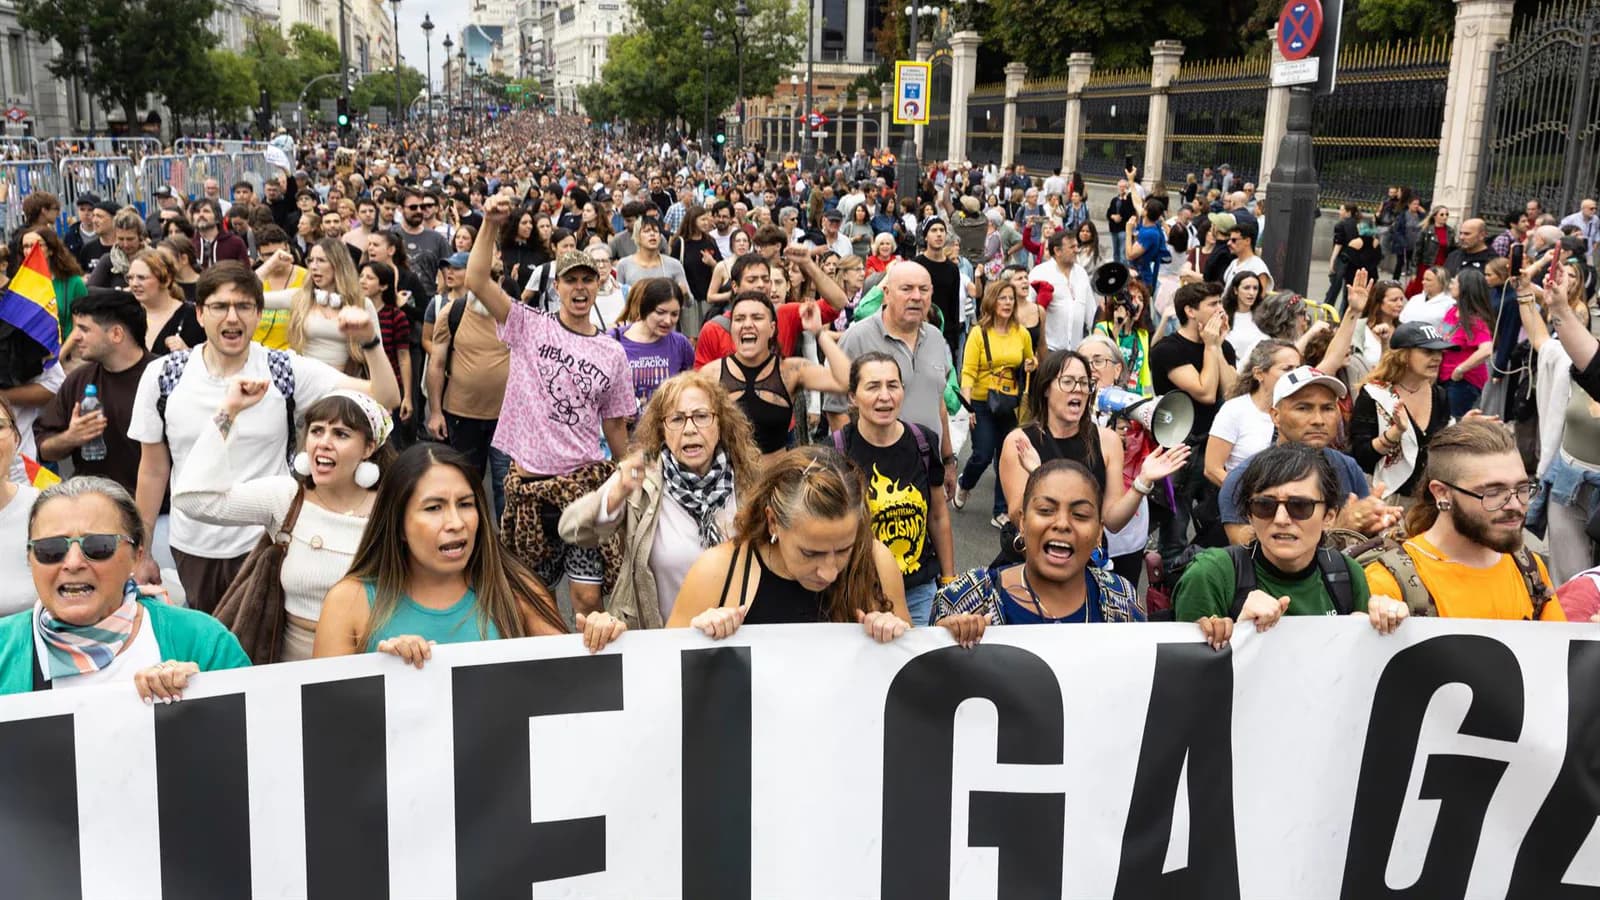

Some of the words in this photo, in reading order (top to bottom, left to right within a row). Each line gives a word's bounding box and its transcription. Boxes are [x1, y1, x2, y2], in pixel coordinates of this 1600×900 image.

[1420, 325, 1442, 339] TR
[577, 358, 611, 392] KITTY
[0, 642, 1240, 900] UELGA
